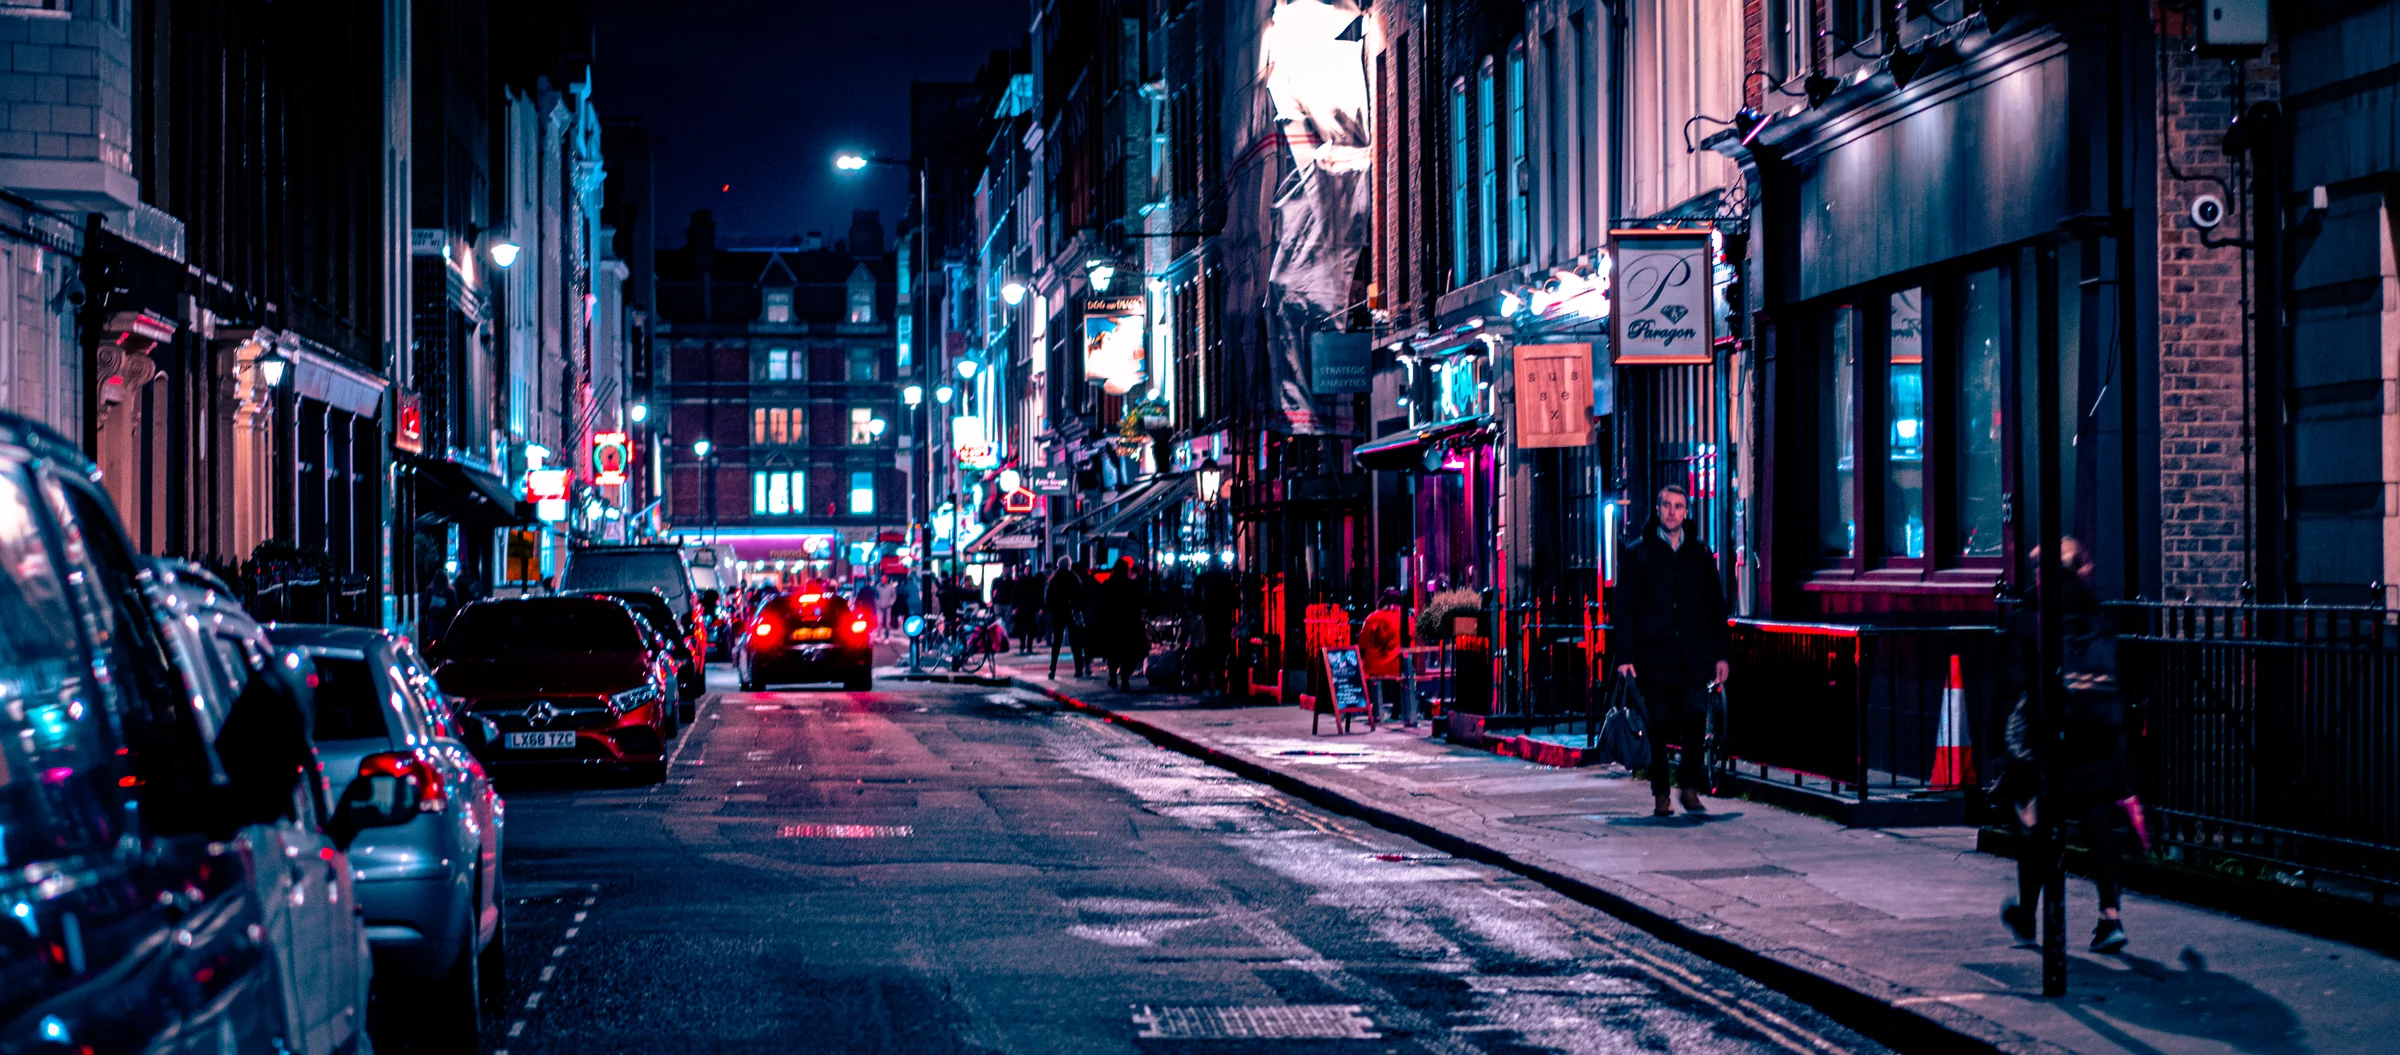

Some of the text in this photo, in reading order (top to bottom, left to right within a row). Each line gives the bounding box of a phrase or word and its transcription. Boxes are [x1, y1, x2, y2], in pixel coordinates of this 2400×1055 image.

[1627, 319, 1696, 347] Paragon
[1319, 365, 1366, 376] STRATEGIC
[1320, 378, 1367, 388] ANALYTICS
[513, 732, 573, 746] LX68 TZC
